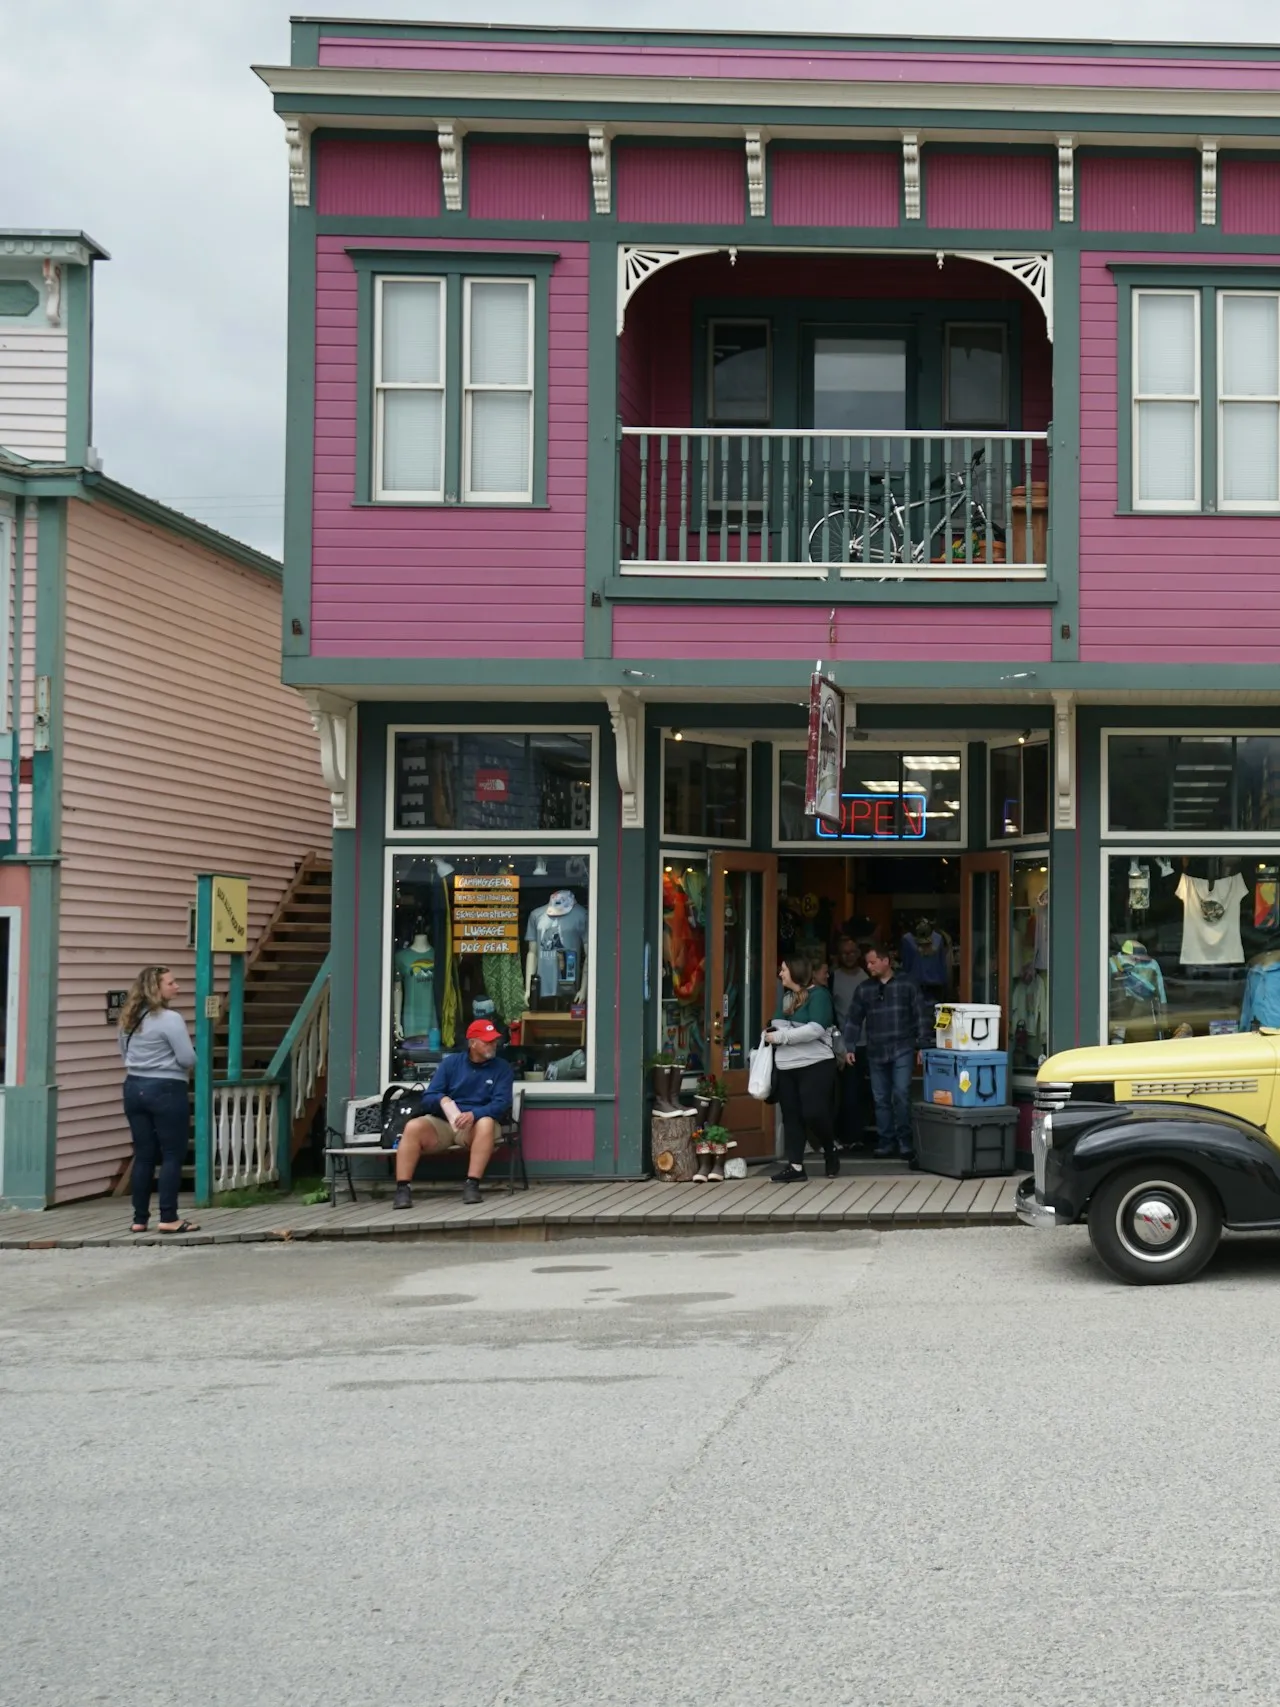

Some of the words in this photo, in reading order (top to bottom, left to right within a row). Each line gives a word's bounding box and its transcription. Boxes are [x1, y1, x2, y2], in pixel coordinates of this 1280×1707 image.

[821, 799, 922, 835] OPEN
[458, 877, 488, 888] CAMPING
[487, 878, 513, 887] GEAR
[464, 925, 506, 936] LUGGAGE
[461, 943, 480, 952] DOG
[483, 942, 510, 952] GEAR
